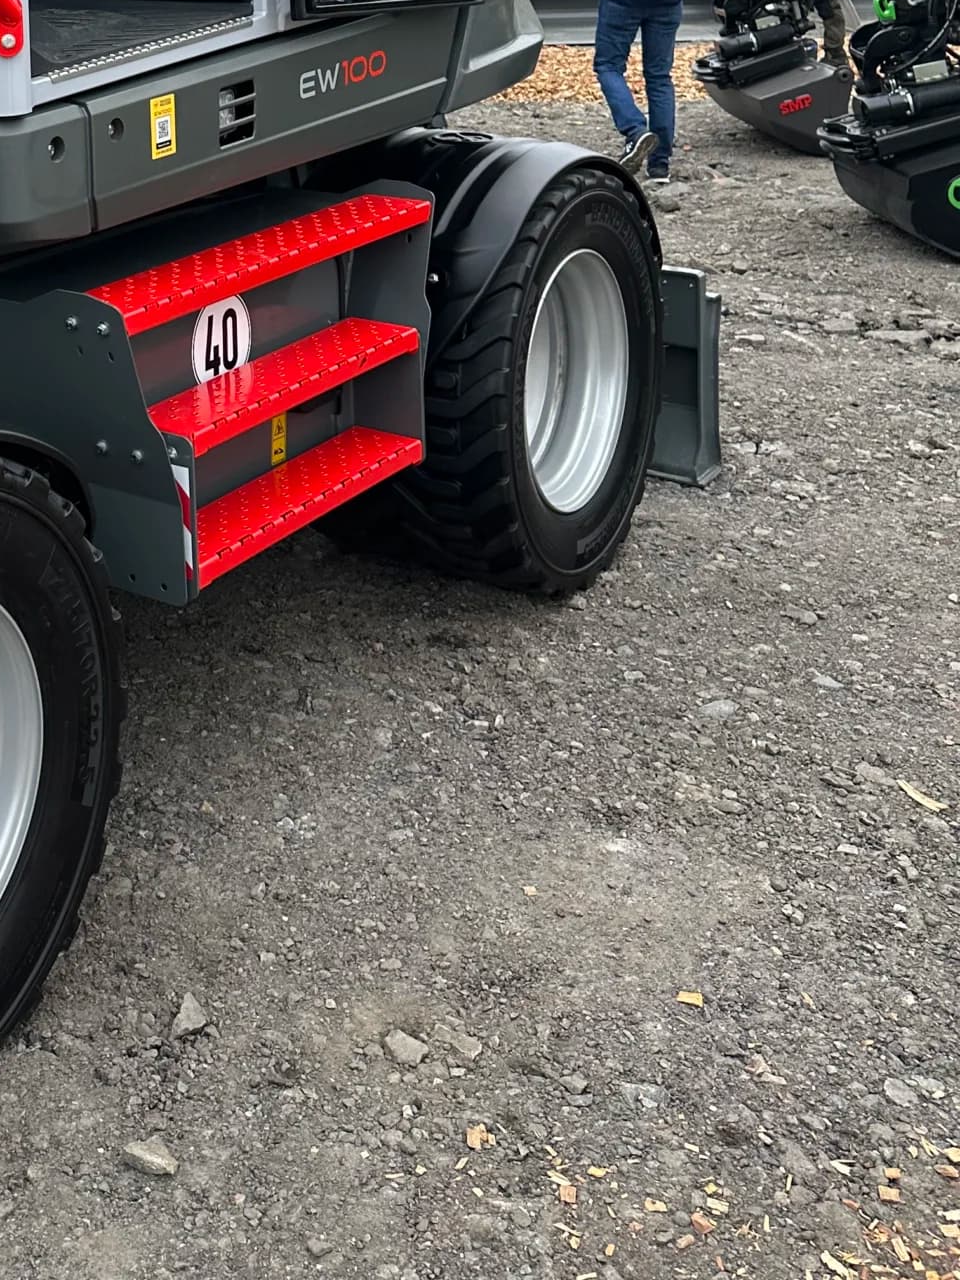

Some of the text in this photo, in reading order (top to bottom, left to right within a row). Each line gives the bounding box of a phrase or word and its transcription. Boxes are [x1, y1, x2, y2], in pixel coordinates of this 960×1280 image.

[299, 50, 387, 100] EW100
[779, 93, 812, 116] SMP
[204, 307, 239, 377] 40
